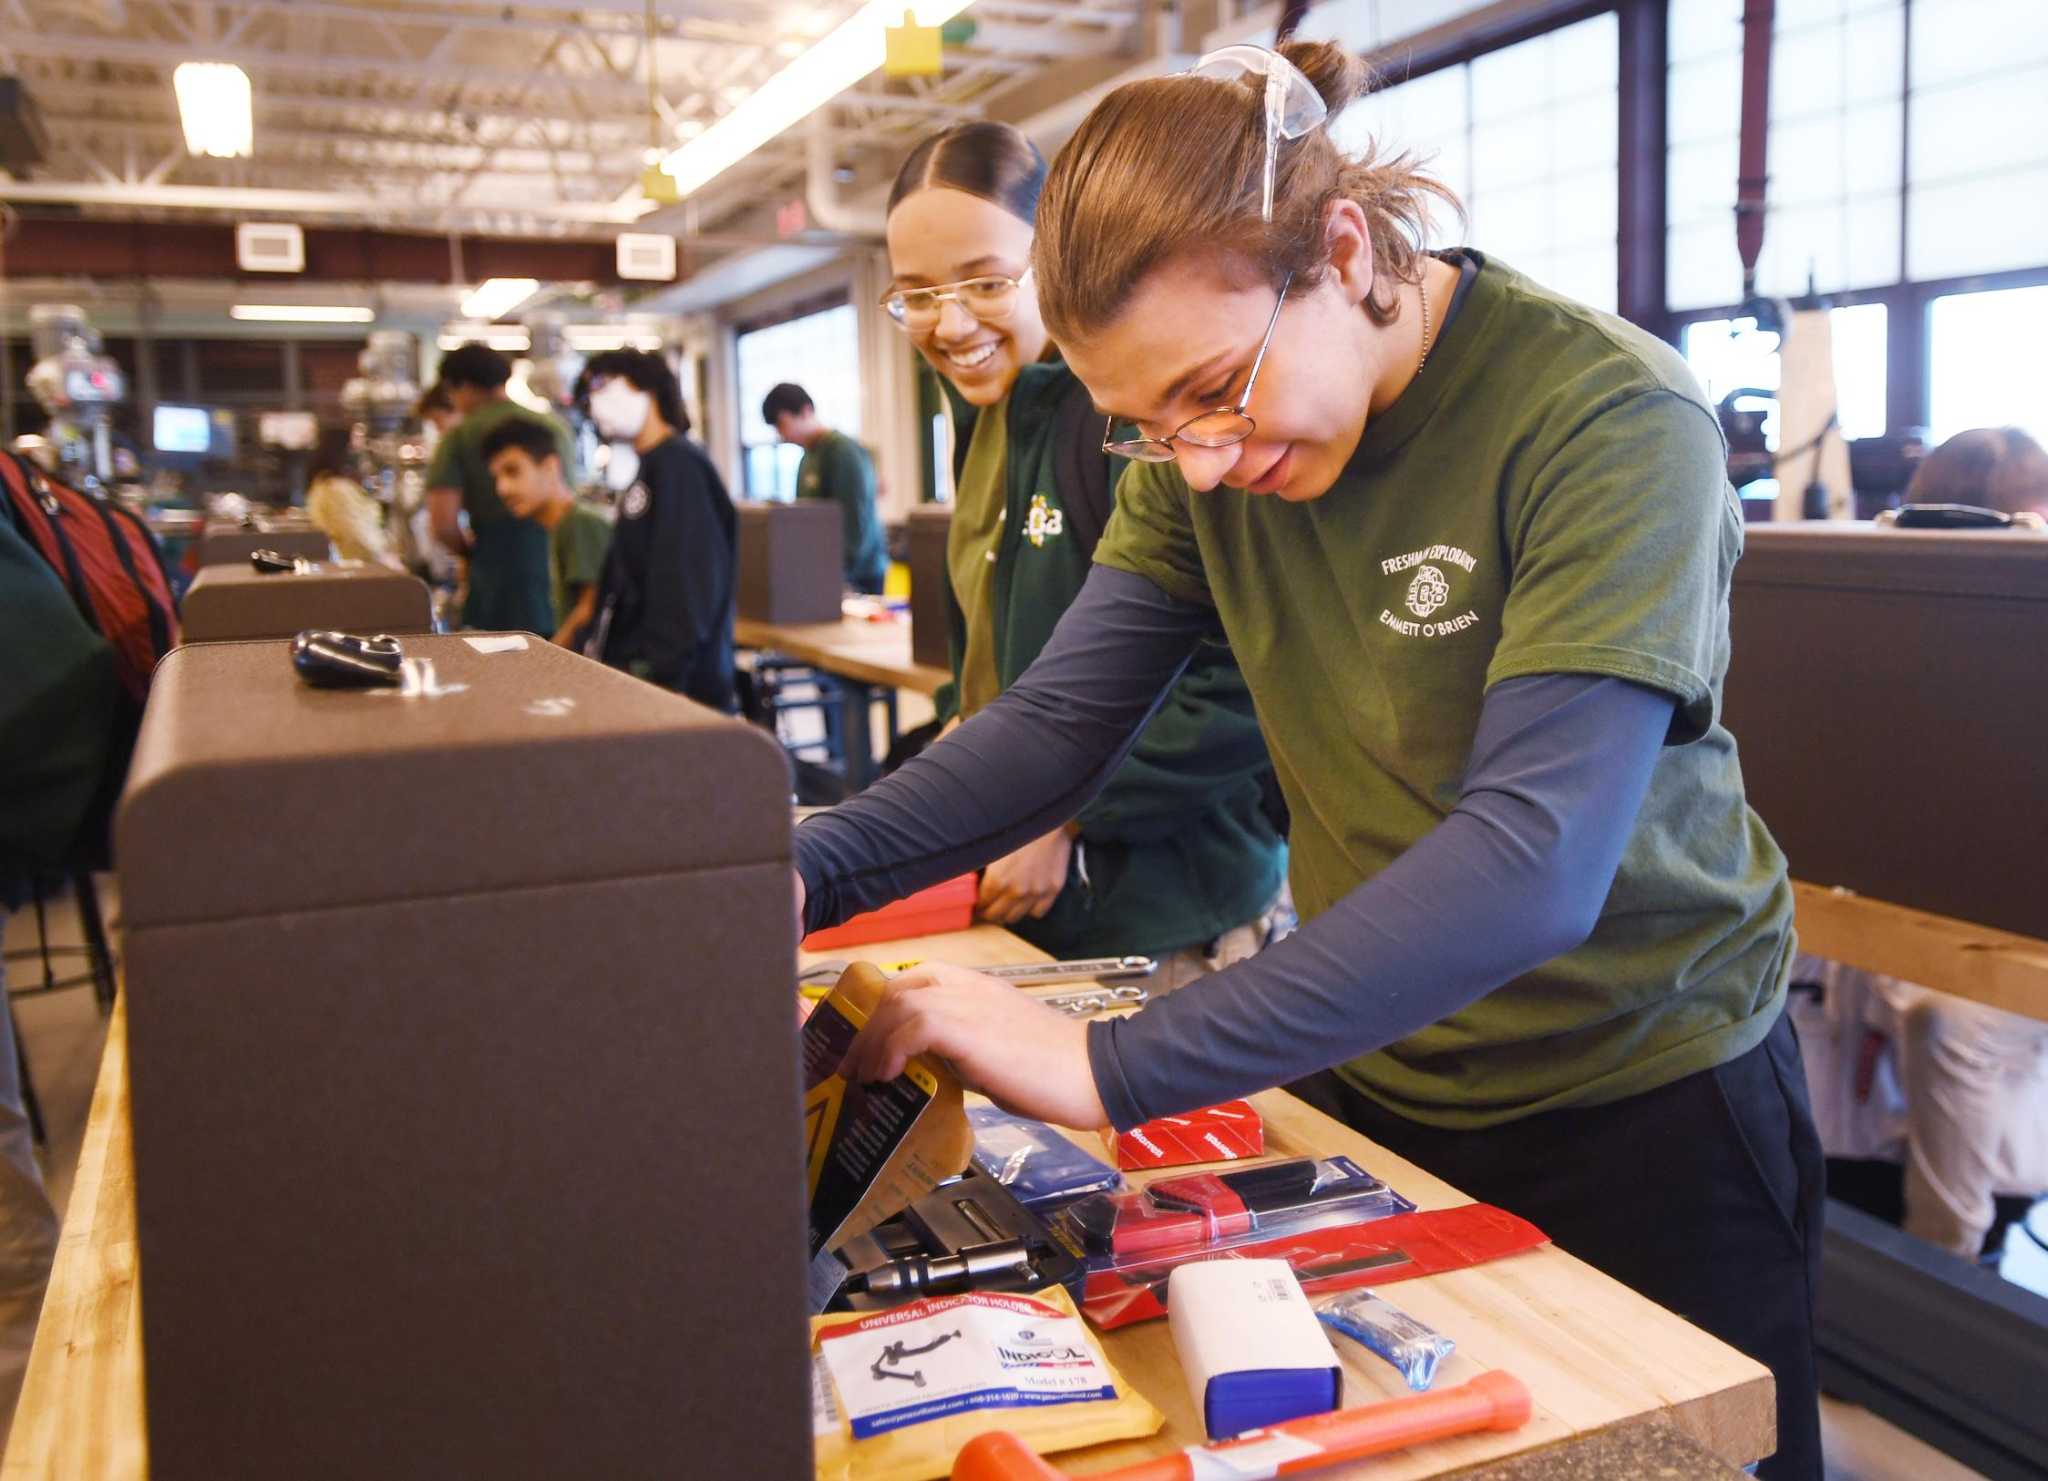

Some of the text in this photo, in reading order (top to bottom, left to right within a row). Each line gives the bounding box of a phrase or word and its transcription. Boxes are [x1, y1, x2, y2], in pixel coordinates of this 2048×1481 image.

[1381, 546, 1430, 576] FRESHMN
[1380, 608, 1480, 637] EMMETT O'BRIEN
[860, 1307, 926, 1329] UNIVERSAL
